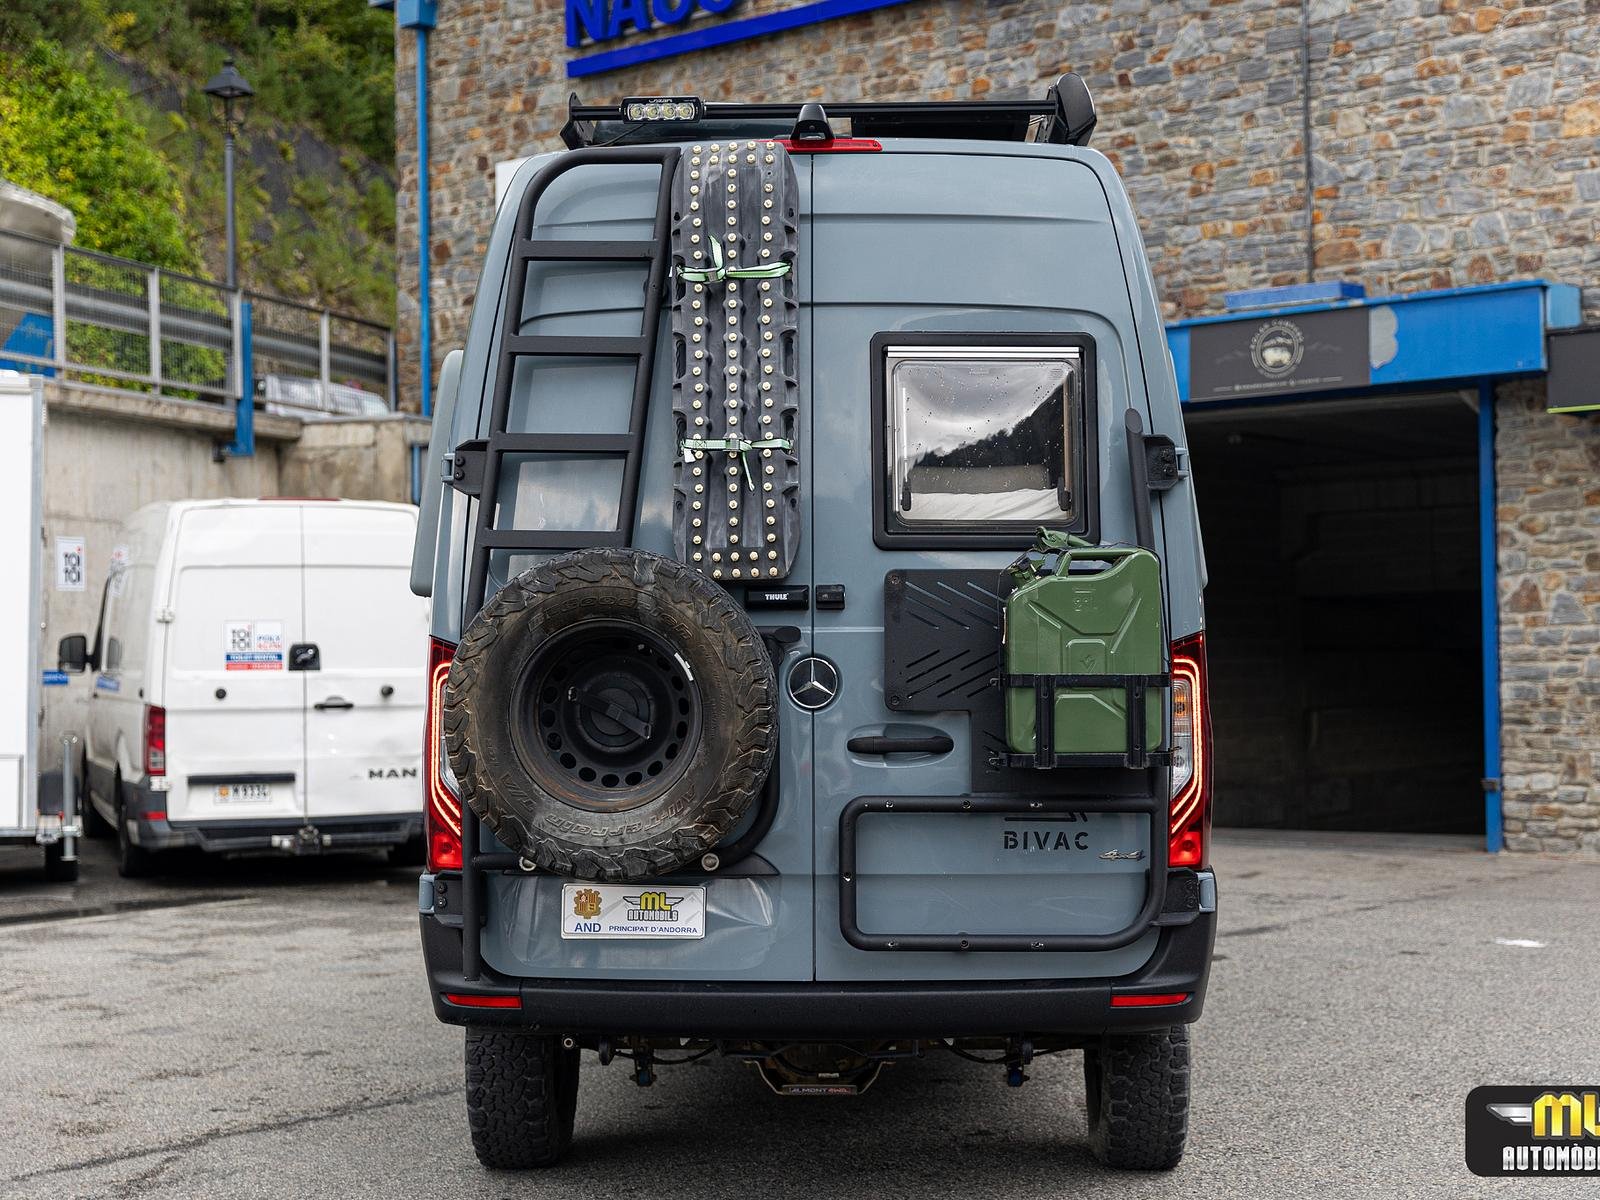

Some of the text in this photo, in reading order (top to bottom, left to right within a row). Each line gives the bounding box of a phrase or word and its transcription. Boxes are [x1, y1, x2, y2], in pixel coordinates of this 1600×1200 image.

[369, 768, 416, 778] MAN
[1003, 831, 1089, 850] BIVAC
[639, 891, 672, 911] ML
[574, 923, 698, 934] AND PRINCIPAT D'ANDORRA
